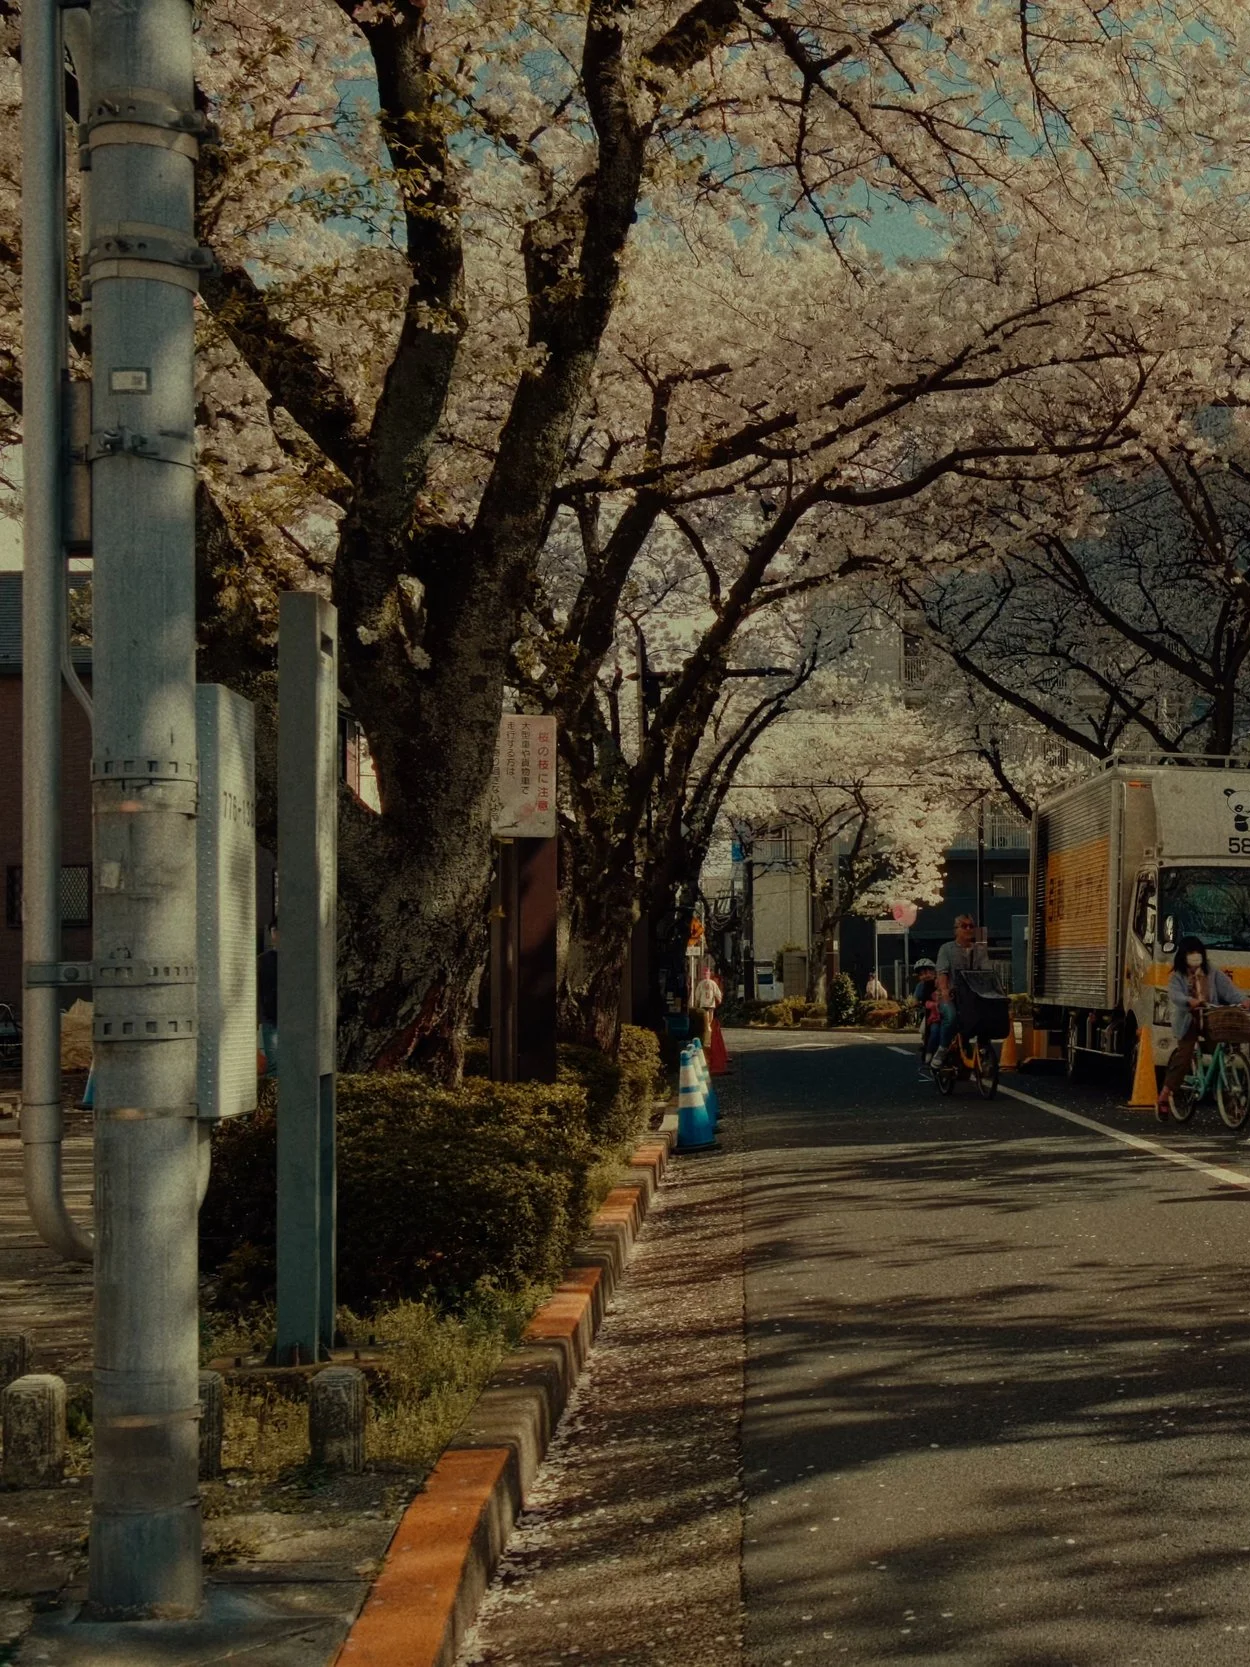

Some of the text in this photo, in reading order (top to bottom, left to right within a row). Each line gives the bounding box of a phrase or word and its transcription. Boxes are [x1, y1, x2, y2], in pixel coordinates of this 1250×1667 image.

[521, 722, 531, 795] 大型車や貨物車で
[538, 732, 549, 812] 桜の枝に注意
